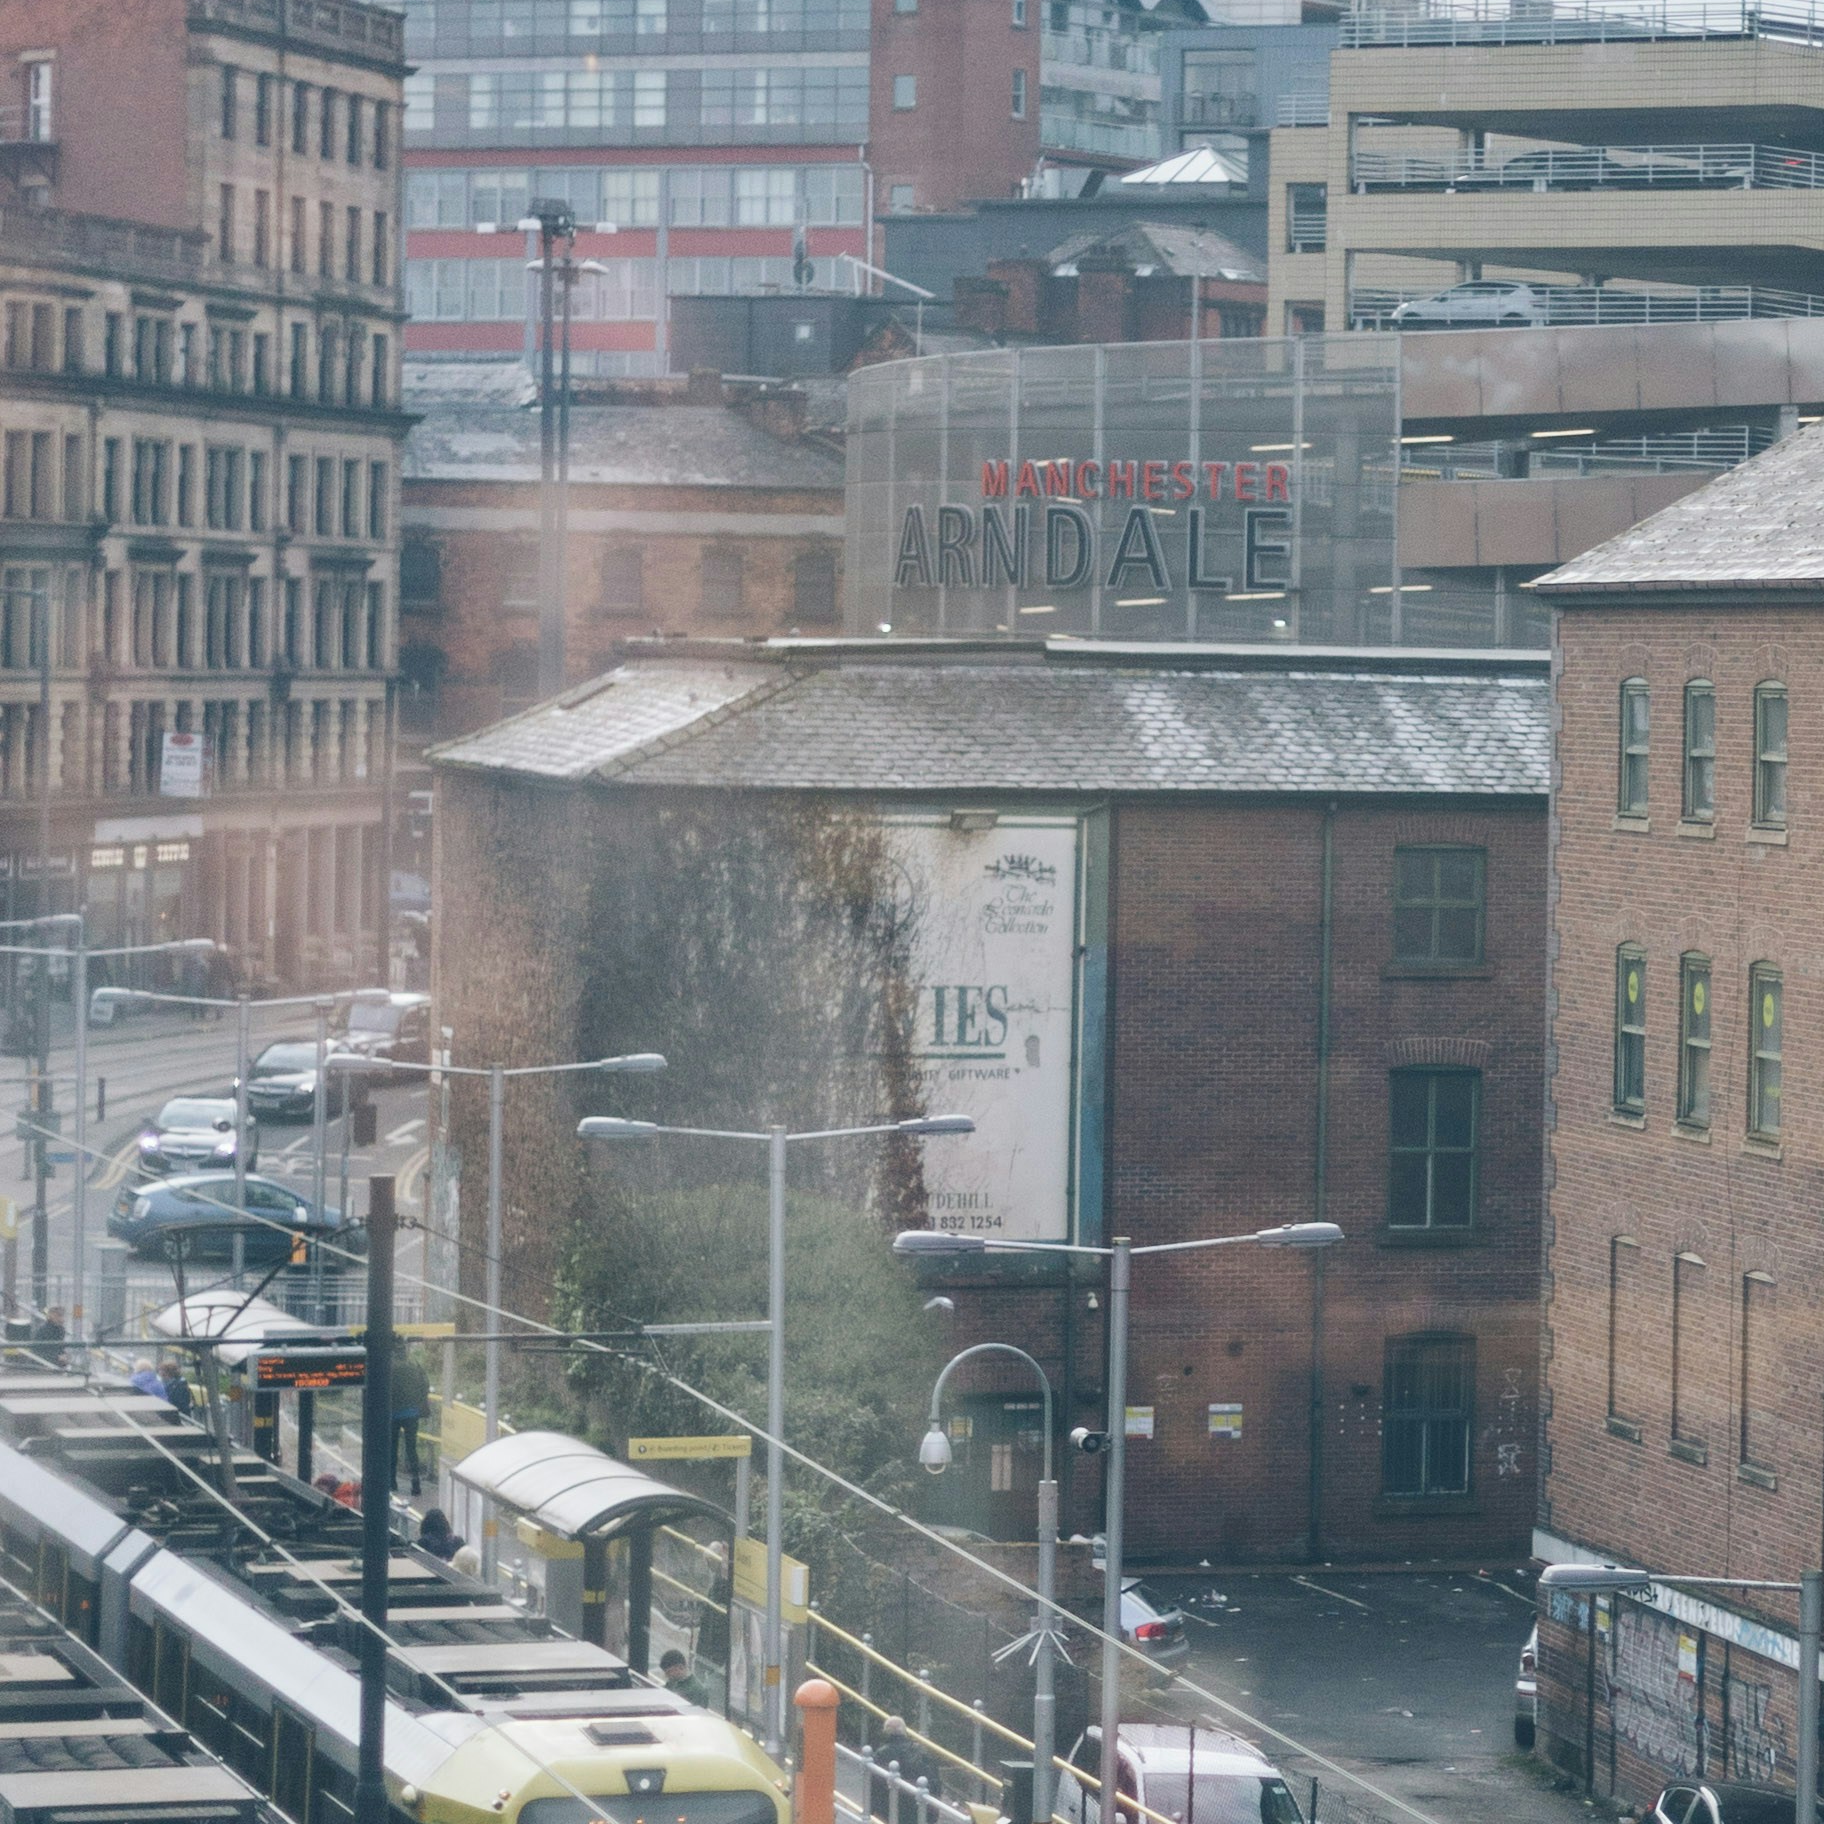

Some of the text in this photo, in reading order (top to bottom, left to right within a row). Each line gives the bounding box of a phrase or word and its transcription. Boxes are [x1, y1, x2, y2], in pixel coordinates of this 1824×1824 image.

[981, 460, 1290, 503] MANCHESTER
[895, 504, 1294, 592] ARNDALE
[940, 1216, 965, 1230] 832
[970, 1216, 1003, 1230] 1254
